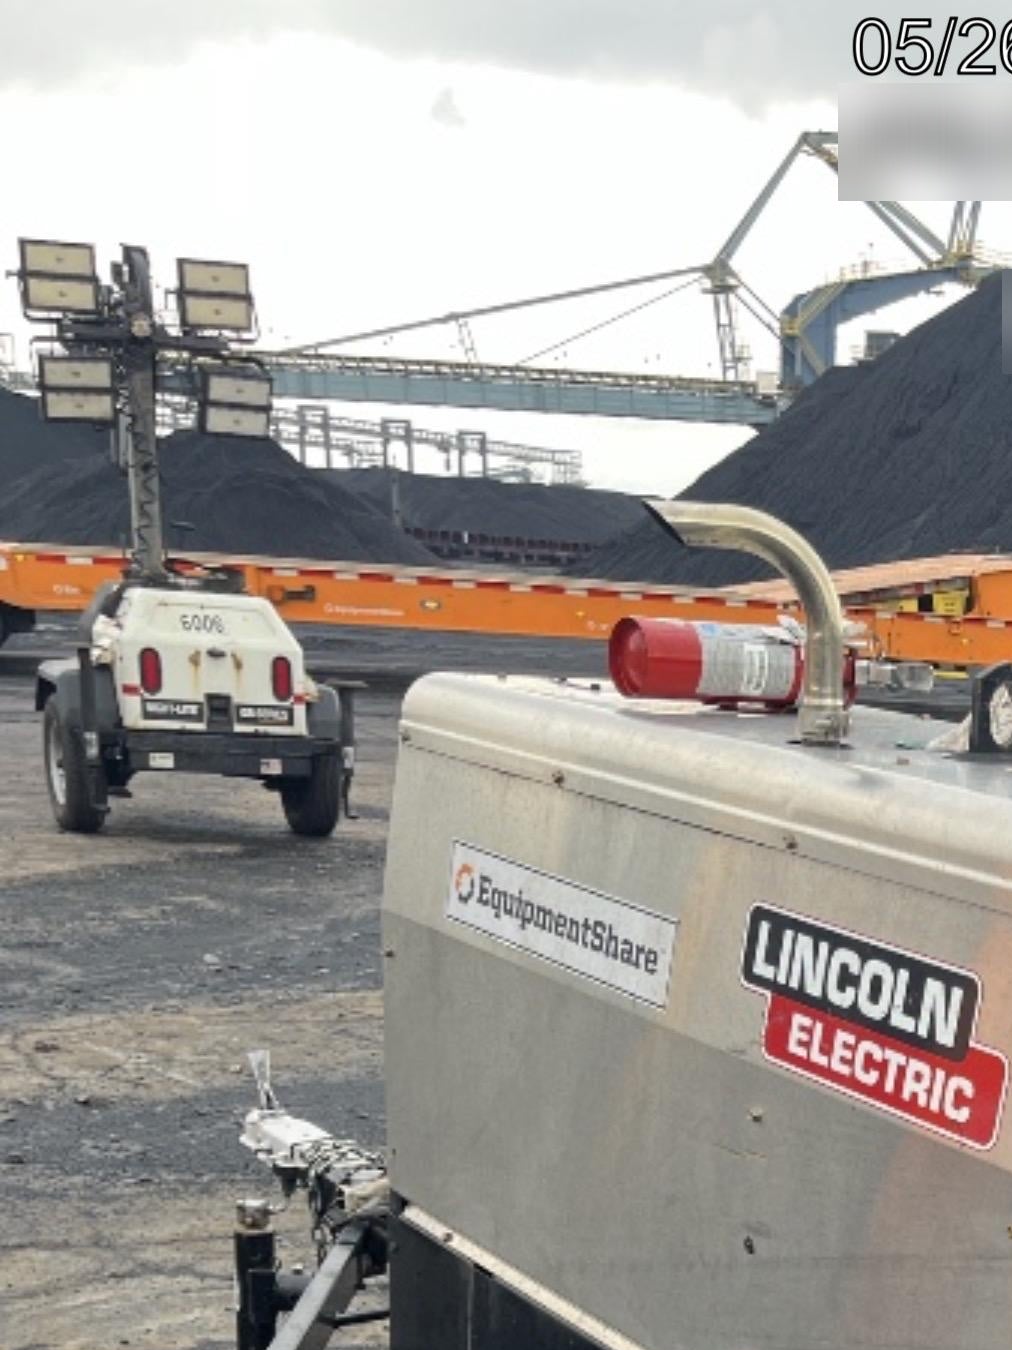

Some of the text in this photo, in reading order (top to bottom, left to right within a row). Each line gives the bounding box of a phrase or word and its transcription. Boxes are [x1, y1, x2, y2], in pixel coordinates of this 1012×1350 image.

[476, 873, 659, 976] EquipmentShare
[752, 920, 964, 1048] LINCOLN
[787, 1013, 975, 1123] ELECTRIC
